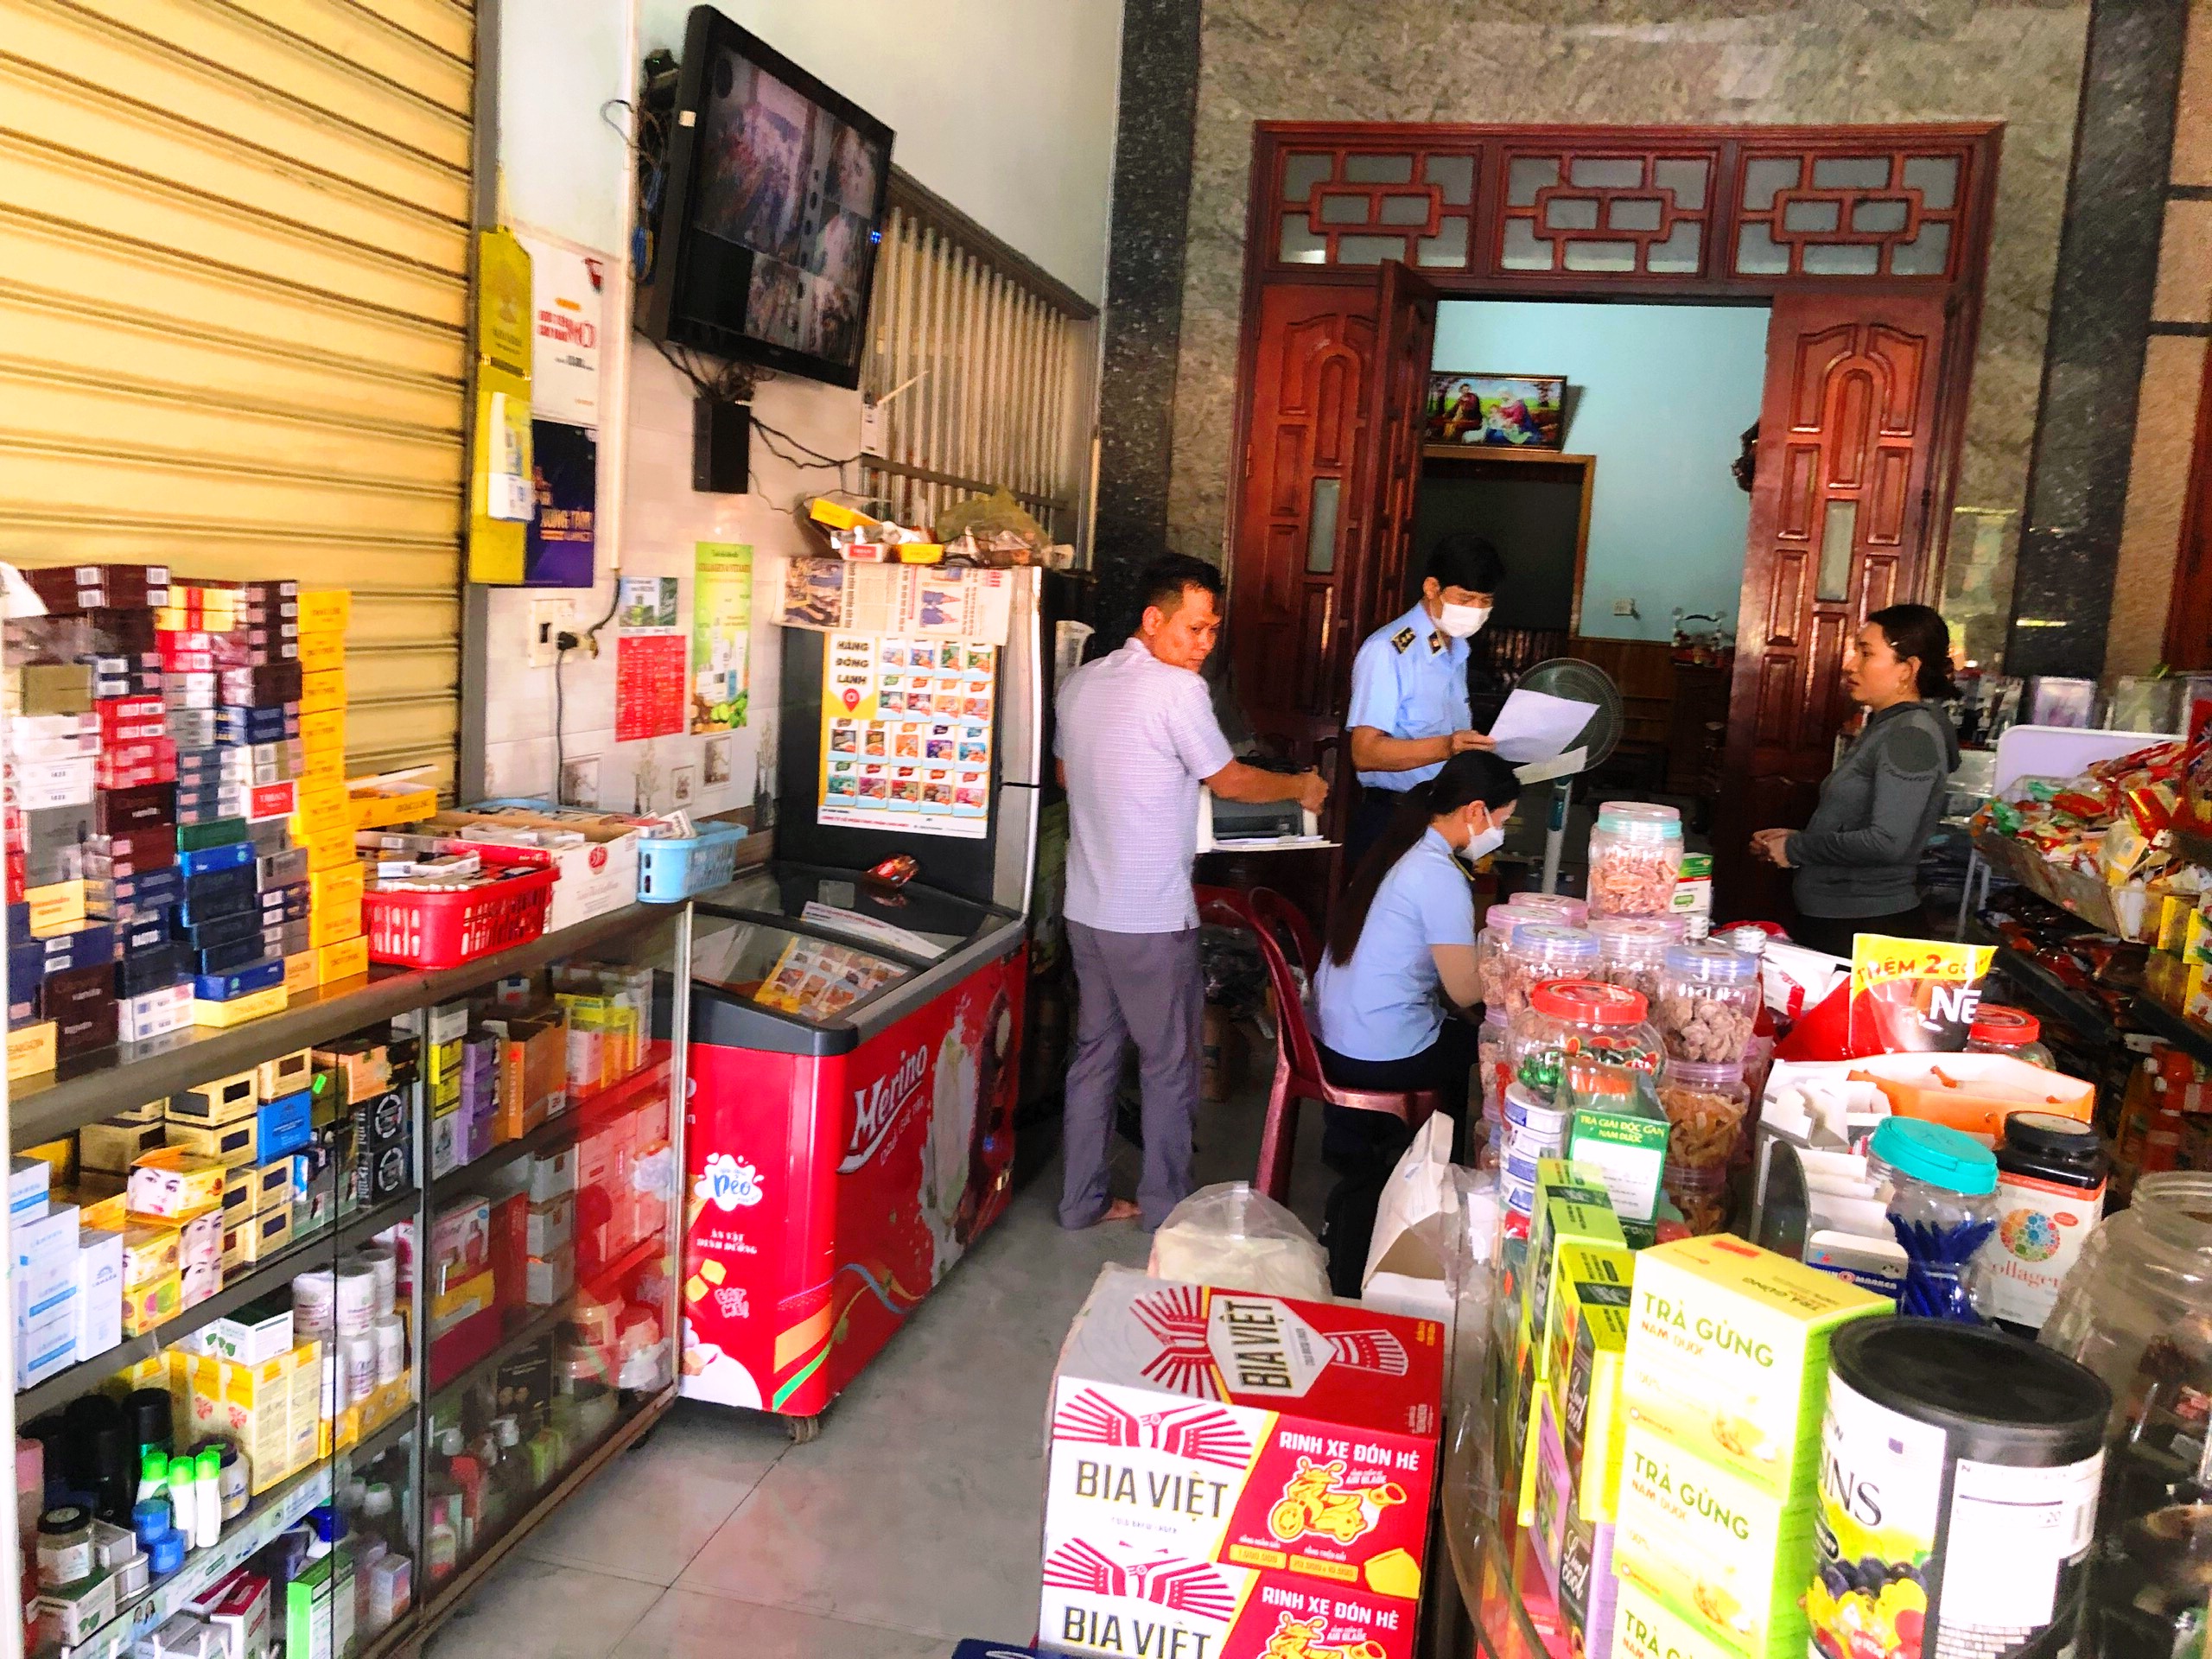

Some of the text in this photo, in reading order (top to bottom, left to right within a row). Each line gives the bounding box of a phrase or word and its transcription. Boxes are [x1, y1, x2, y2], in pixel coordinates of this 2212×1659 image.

[1923, 954, 1942, 974] 2
[850, 1045, 928, 1151] Merino
[1641, 1320, 1669, 1340] NAM
[1643, 1292, 1688, 1330] TRÀ
[1218, 1300, 1293, 1389] BIA VIỆT
[1279, 1431, 1323, 1454] RINH
[1325, 1439, 1350, 1459] XE
[1353, 1443, 1393, 1466] ĐÓN
[1075, 1459, 1229, 1522] BIA VIỆT
[1632, 1479, 1656, 1501] NAM
[1634, 1452, 1671, 1494] TRÀ
[1262, 1586, 1305, 1610] RINH
[1306, 1594, 1331, 1616] XE
[1335, 1600, 1372, 1624] ĐÓN
[1062, 1604, 1122, 1651] BIA
[1624, 1609, 1659, 1656] TRÀ
